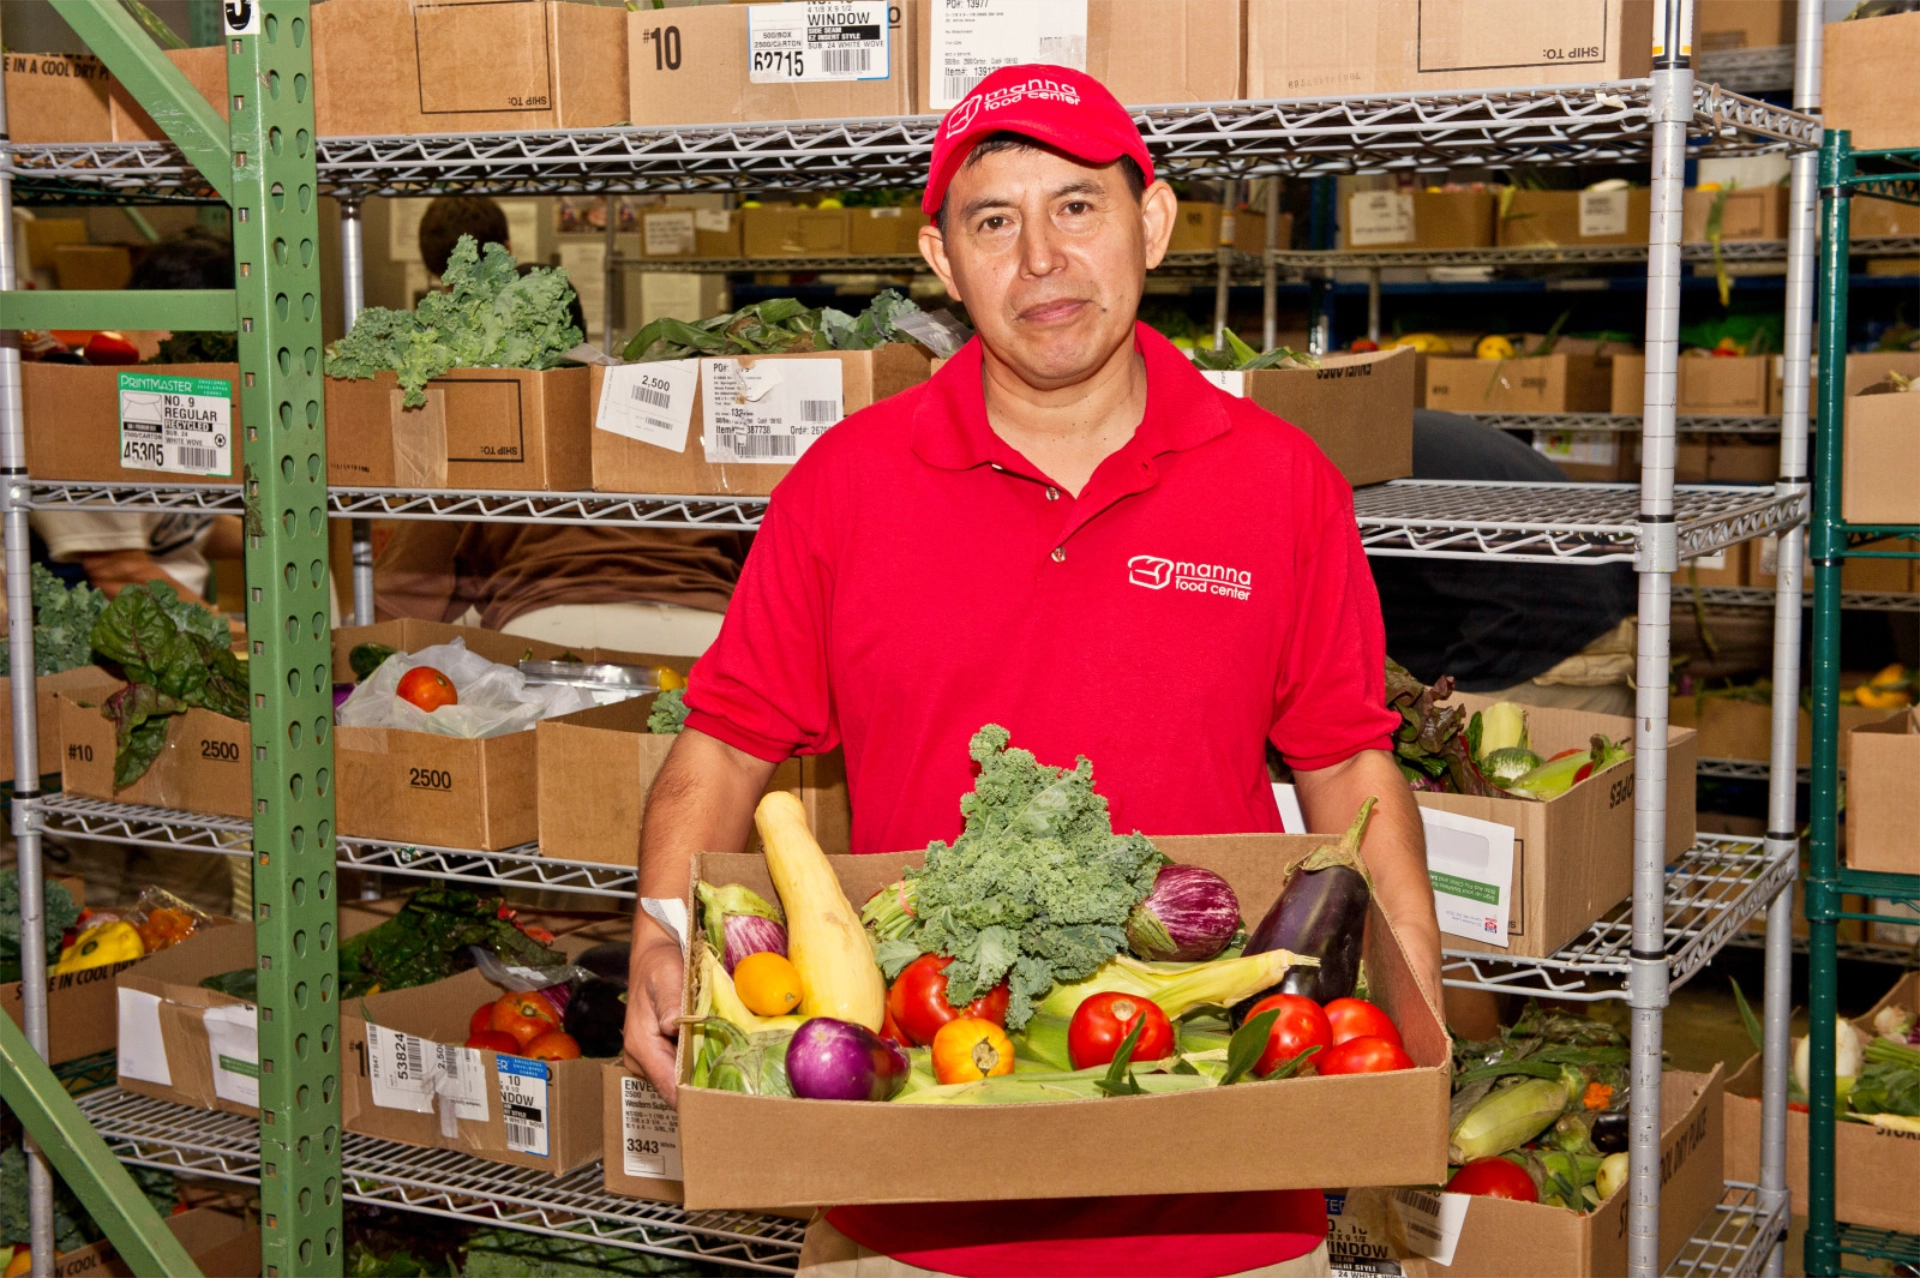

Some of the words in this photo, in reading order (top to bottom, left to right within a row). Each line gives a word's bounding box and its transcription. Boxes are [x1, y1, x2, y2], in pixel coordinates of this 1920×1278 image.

[807, 12, 870, 26] WINDOW
[642, 25, 682, 70] #10
[1543, 48, 1564, 60] TO:
[1568, 47, 1599, 59] SHIP
[13, 57, 26, 72] IN
[29, 59, 37, 74] A
[42, 60, 70, 77] COOL
[73, 64, 96, 78] DRY
[754, 51, 804, 77] 62715
[985, 79, 1077, 101] manna
[508, 96, 524, 106] TO:
[526, 96, 547, 106] SHIP
[984, 93, 1022, 111] food
[1028, 92, 1081, 106] center
[121, 375, 192, 392] PRINTMASTER
[642, 375, 670, 391] 2,500
[164, 395, 184, 407] NO.
[188, 397, 195, 408] 9
[164, 407, 217, 421] REGULAR
[165, 420, 209, 431] RECYCLED
[124, 441, 164, 466] 45305
[480, 446, 496, 455] TO:
[498, 446, 518, 455] SHIP
[1176, 562, 1252, 585] manna
[1176, 578, 1207, 593] food
[1210, 584, 1251, 601] center
[68, 744, 94, 762] #10
[201, 740, 240, 760] 2500
[409, 767, 452, 789] 2500
[59, 973, 73, 990] IN
[76, 965, 108, 986] COOL
[395, 1033, 409, 1080] 53824
[508, 1075, 521, 1087] 10
[627, 1138, 659, 1154] 3343
[1355, 1235, 1366, 1243] 1/2
[67, 1254, 97, 1276] COOL
[1355, 1264, 1377, 1272] STYLE
